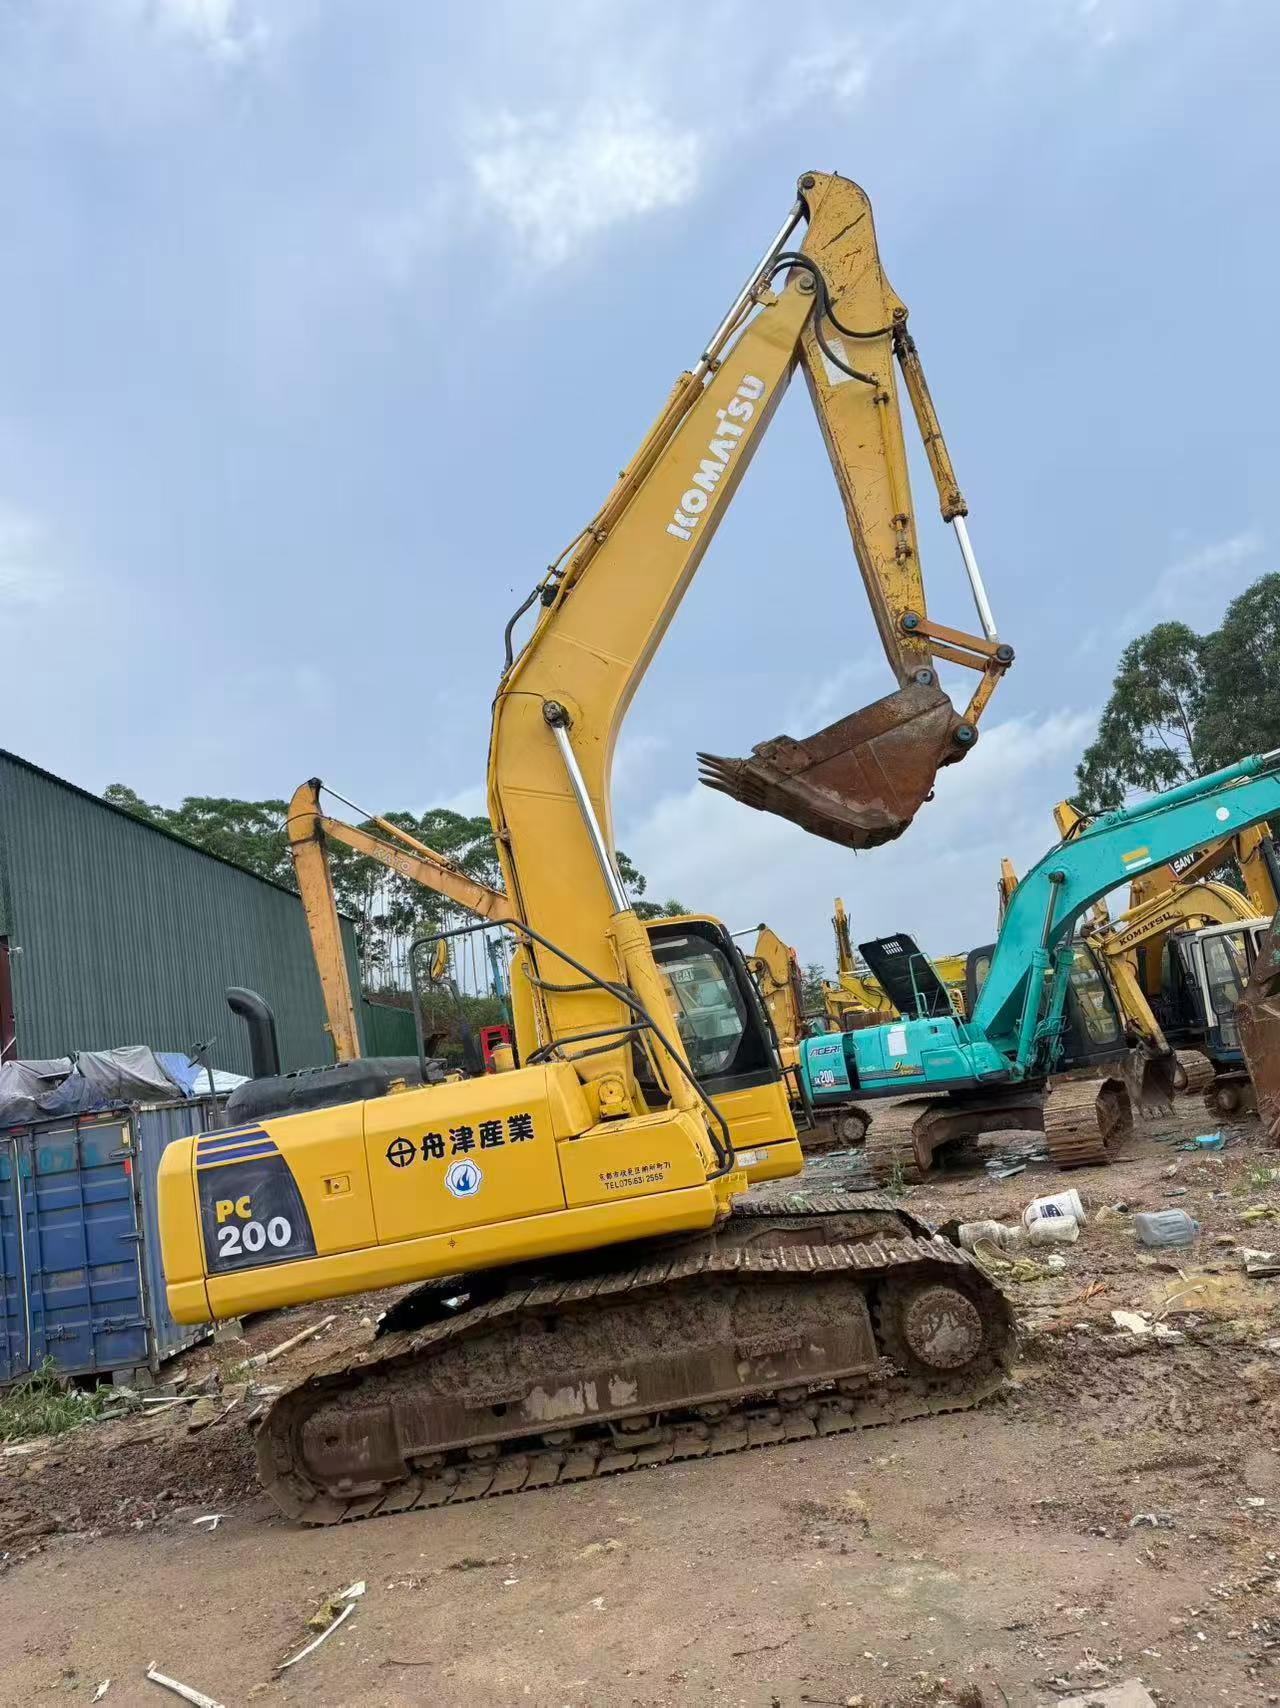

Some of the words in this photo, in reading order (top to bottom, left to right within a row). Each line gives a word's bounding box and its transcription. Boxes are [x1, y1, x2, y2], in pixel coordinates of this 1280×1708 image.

[665, 374, 765, 541] KOMATSU
[373, 848, 411, 871] KATO
[1173, 852, 1195, 873] SANY
[1119, 911, 1171, 946] KOMATSU
[421, 1113, 534, 1161] 舟津産業
[216, 1195, 252, 1223] PC
[218, 1216, 292, 1257] 200
